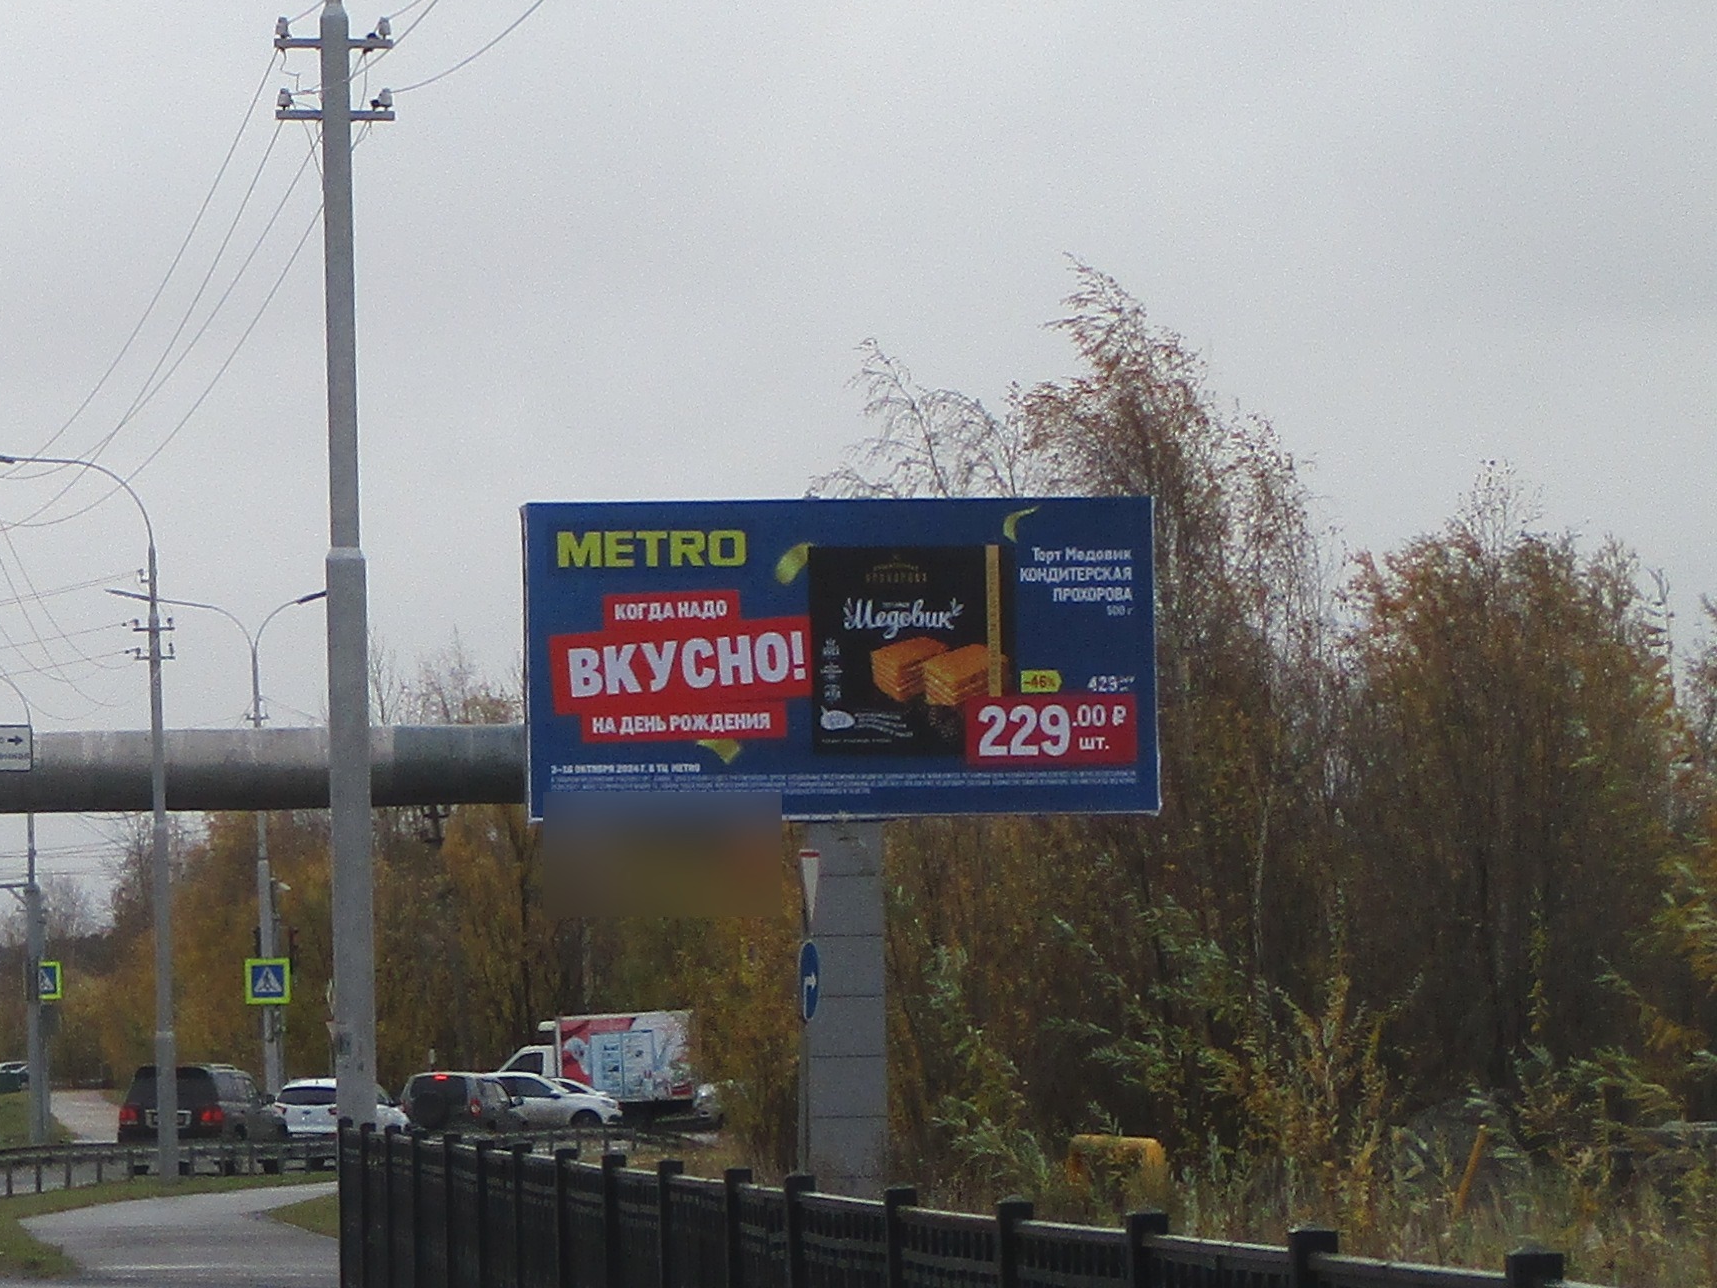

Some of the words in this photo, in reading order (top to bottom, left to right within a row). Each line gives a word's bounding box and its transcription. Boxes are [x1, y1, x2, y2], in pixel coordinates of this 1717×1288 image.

[556, 529, 747, 568] METRO
[1031, 547, 1061, 564] Торт
[1065, 547, 1133, 561] Медовик
[1019, 567, 1133, 583] КОНДИТЕРСКАЯ
[1052, 587, 1133, 602] ПРОХОРОВА
[614, 602, 675, 621] КОГДА
[677, 600, 727, 618] НАДО
[843, 598, 955, 639] Медовик
[568, 631, 806, 698] ВКУСНО!
[593, 716, 616, 734] НА
[619, 714, 666, 734] ДЕНЬ
[670, 712, 771, 732] РОЖДЕНИЯ
[977, 704, 1071, 757] 229
[1078, 737, 1110, 750] шт.
